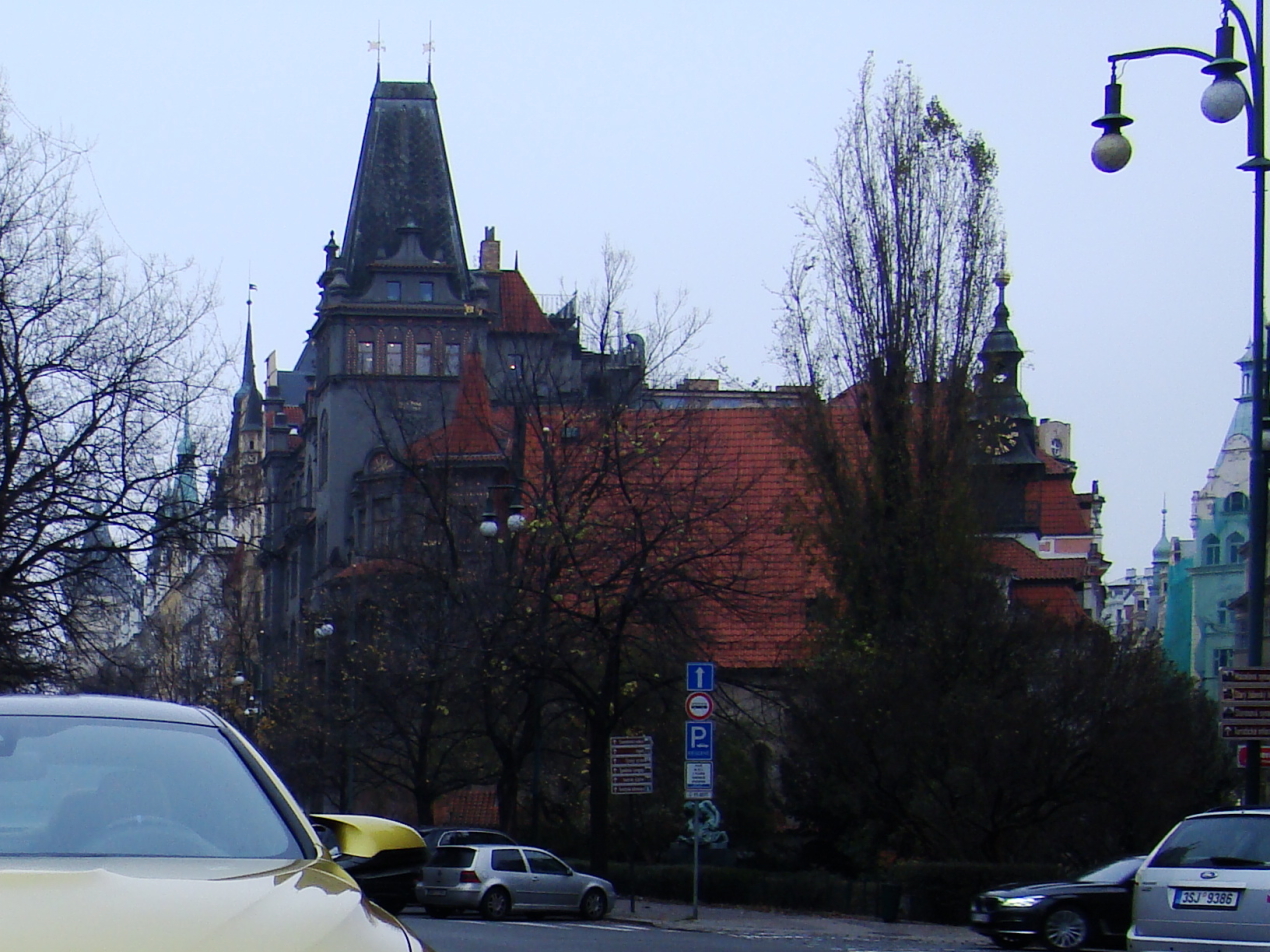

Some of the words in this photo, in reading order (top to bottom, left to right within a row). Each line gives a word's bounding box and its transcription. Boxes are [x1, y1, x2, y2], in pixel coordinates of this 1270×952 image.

[691, 726, 707, 748] P
[1182, 892, 1201, 904] 3SJ
[1206, 893, 1233, 905] 9386
